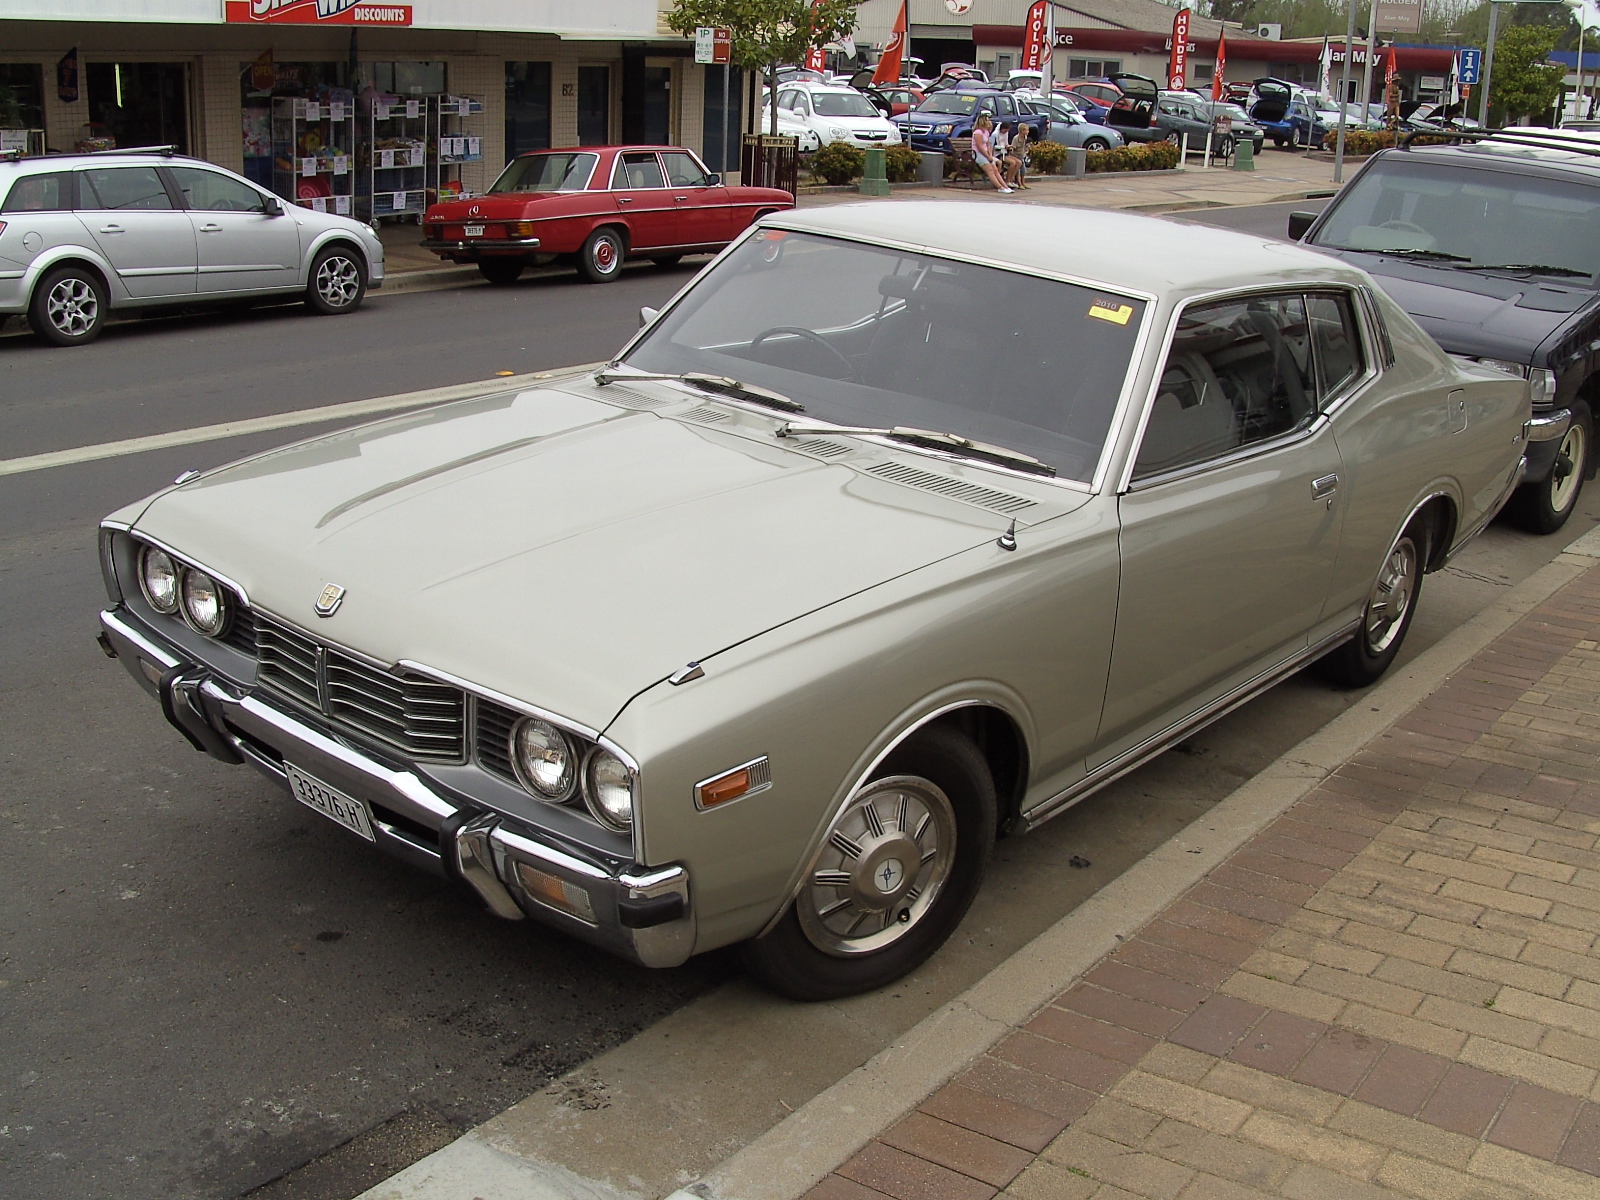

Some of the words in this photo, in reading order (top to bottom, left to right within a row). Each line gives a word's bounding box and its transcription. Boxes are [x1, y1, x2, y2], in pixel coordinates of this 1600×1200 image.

[354, 7, 405, 21] DISCOUNTS
[699, 29, 710, 38] 1P
[1175, 15, 1187, 74] HOLDEN
[1352, 50, 1382, 66] My
[1095, 299, 1117, 309] 2010
